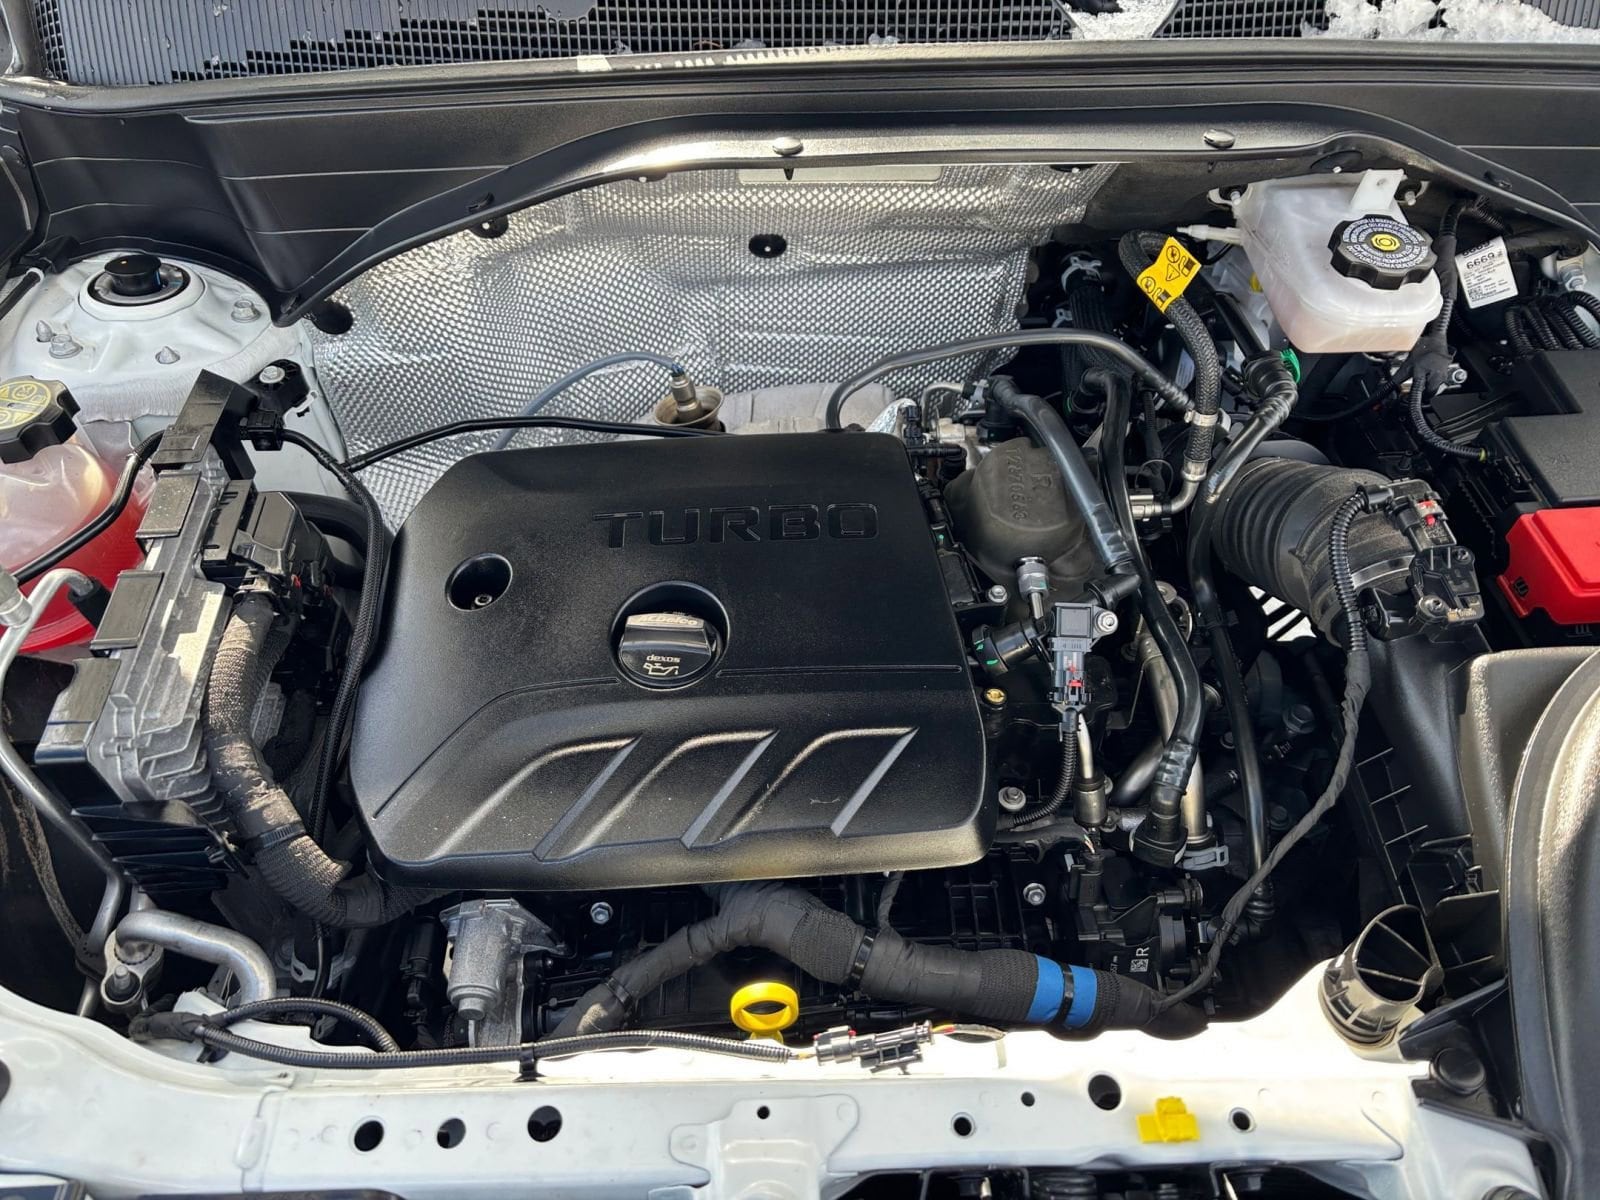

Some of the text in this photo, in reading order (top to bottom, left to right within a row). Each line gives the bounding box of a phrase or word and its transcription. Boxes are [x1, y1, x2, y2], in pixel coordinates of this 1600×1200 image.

[592, 503, 879, 550] TURBO
[646, 654, 681, 663] dexos
[1136, 947, 1150, 957] R
